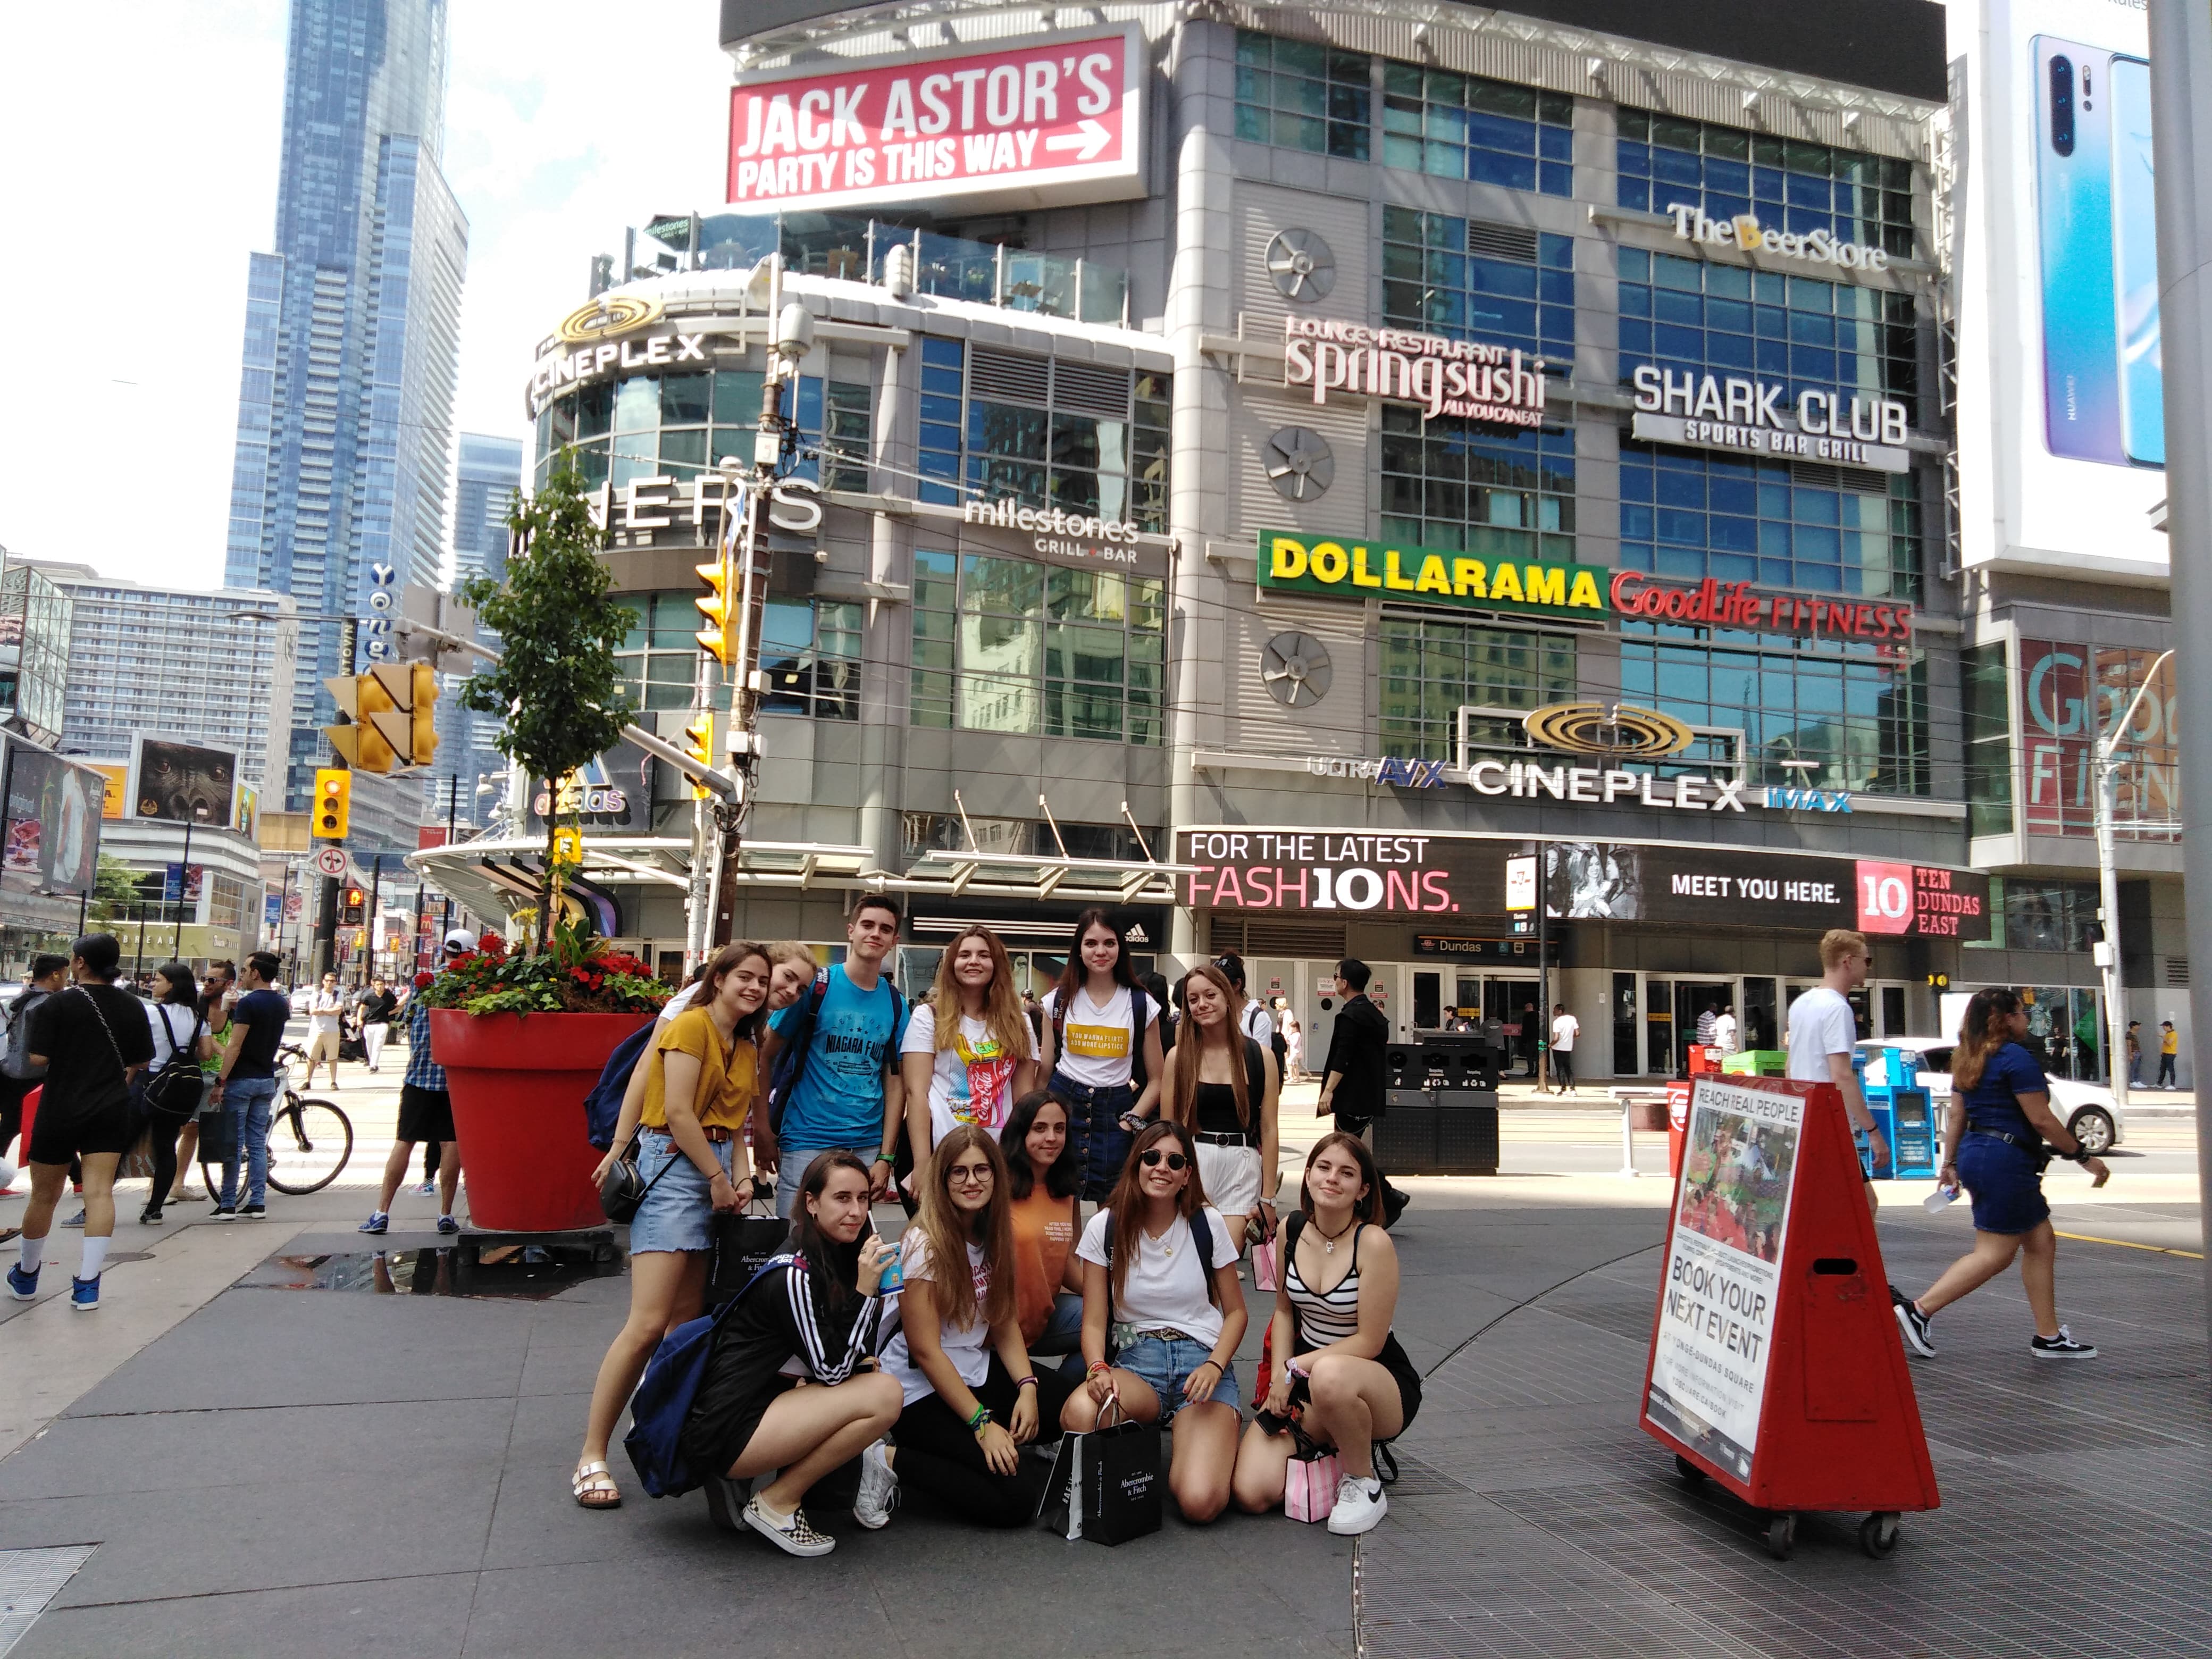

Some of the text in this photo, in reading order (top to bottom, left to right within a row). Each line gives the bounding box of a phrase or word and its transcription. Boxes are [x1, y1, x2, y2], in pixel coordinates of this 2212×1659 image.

[2108, 0, 2149, 11] ates
[738, 52, 1112, 158] JACK ASTOR'S
[738, 128, 1040, 199] PARTY IS THIS WAY
[532, 333, 705, 395] CINEPLEX
[1633, 365, 1908, 445] SHARK CLUB
[2066, 375, 2076, 421] HUAWEI
[1685, 420, 1870, 463] SPORTS BAR GRILL
[965, 498, 1139, 544] milestones
[1034, 538, 1137, 564] GRILL BAR
[1270, 538, 1602, 609] DOLLARAMA
[1610, 571, 1914, 640] GoodLife FITNESS
[341, 624, 354, 677] NTOWN
[1469, 761, 1746, 812] CINEPLEX
[1763, 787, 1853, 814] IMAX
[2031, 745, 2179, 814] FITN
[1191, 834, 1430, 864] FOR THE LATEST
[1671, 874, 1840, 904] MEET YOU HERE.
[1863, 876, 1908, 919] 10
[1916, 868, 1951, 891] TEN
[1917, 891, 1980, 916] DUNDAS
[123, 935, 174, 944] BREAD
[1439, 940, 1482, 952] Dundas
[1917, 915, 1959, 936] EAST
[825, 1034, 863, 1054] NIAGARA
[1698, 1087, 1800, 1124] REACH REAL PEOPLE.
[1672, 1255, 1715, 1301] BOOK
[1720, 1276, 1766, 1326] YOUR
[1665, 1288, 1764, 1364] NEXT EVENT
[1672, 1335, 1722, 1374] YONGE-DUNDAS
[1723, 1367, 1754, 1394] SQUARE
[1690, 1370, 1727, 1402] INFORMATION
[1120, 1472, 1154, 1489] Abercrombie
[1133, 1484, 1146, 1495] Fitch
